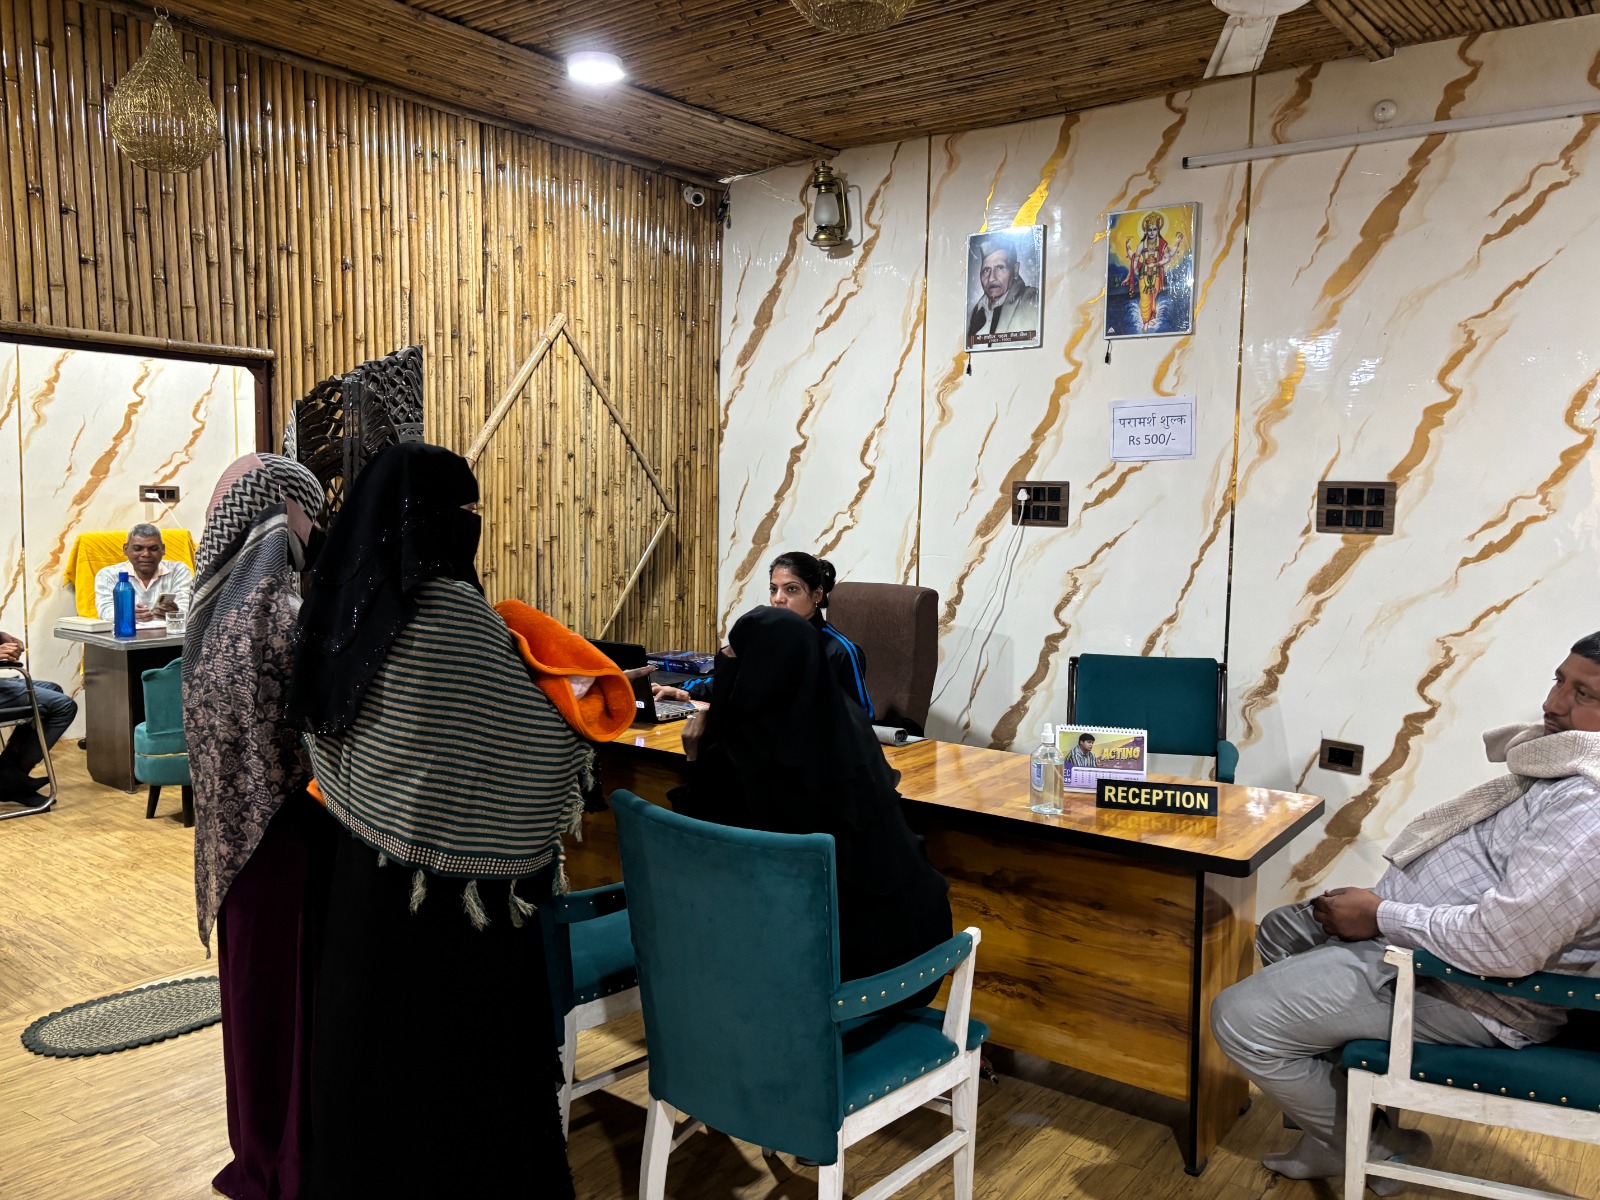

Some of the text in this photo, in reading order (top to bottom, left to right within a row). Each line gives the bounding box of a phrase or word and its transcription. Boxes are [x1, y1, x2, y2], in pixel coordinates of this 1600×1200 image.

[1118, 412, 1187, 429] परामर्श शुल्क
[1128, 432, 1176, 446] Rs 500/-
[1102, 746, 1141, 760] ACTING
[1104, 785, 1209, 810] RECEPTION
